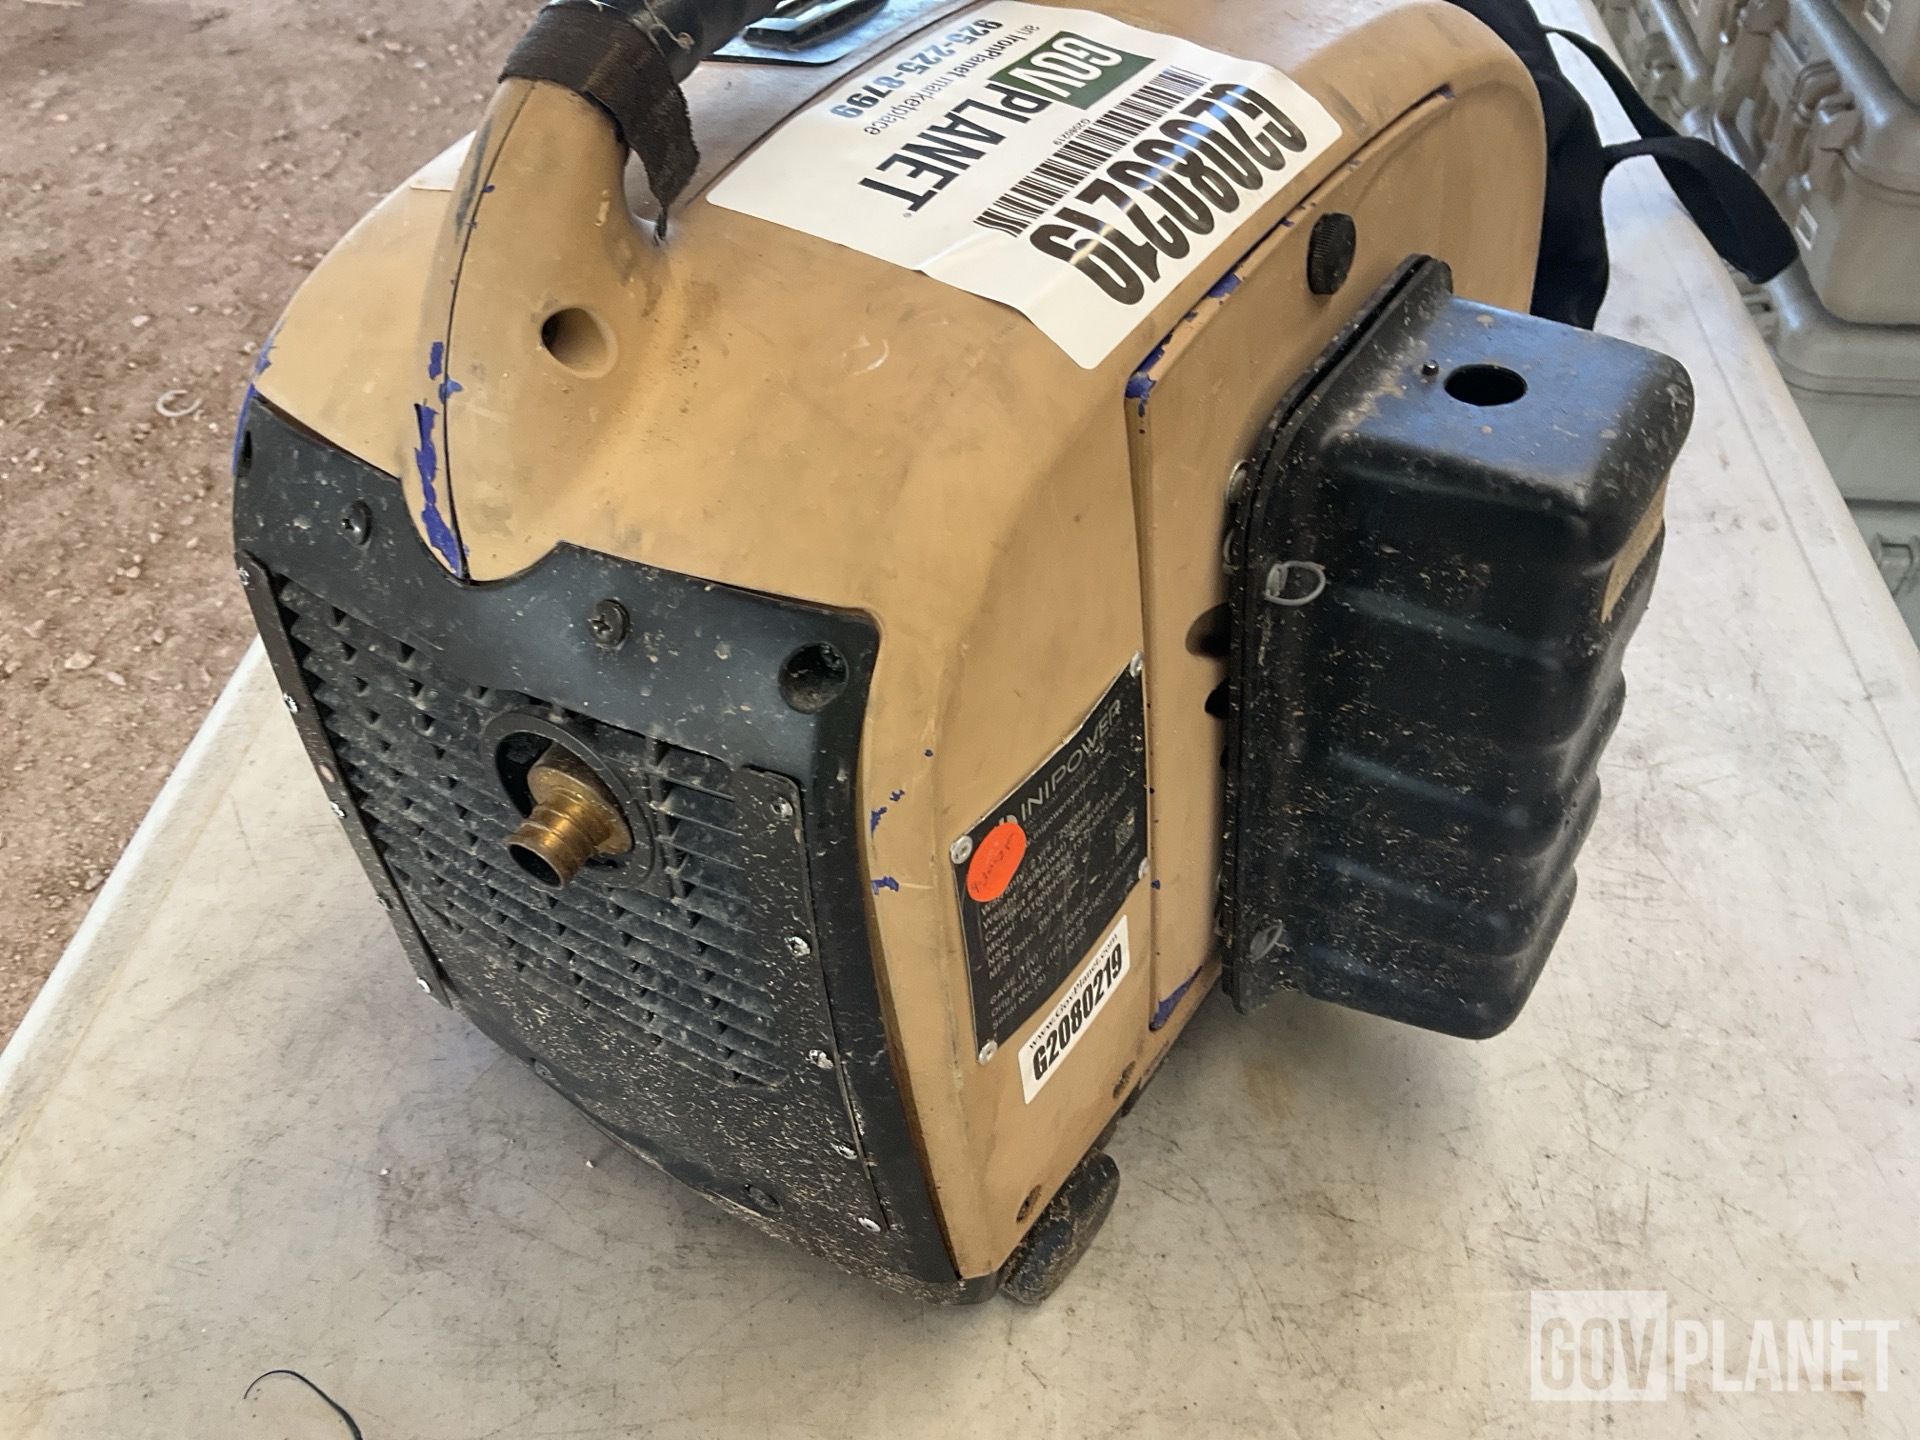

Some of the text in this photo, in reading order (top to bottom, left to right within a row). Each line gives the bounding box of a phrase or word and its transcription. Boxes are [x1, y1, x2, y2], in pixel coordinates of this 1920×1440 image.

[828, 17, 1001, 119] 925-225-8799
[853, 35, 1125, 211] GOV PLANET
[859, 23, 1039, 135] an IronPlanet marketplace
[1050, 117, 1090, 144] G2080219
[1030, 83, 1307, 305] G2080219
[1021, 699, 1121, 821] INIPOWER
[985, 895, 1029, 944] Contract
[1029, 933, 1118, 1049] www.GovPlanet.com
[1032, 943, 1122, 1080] G2080219
